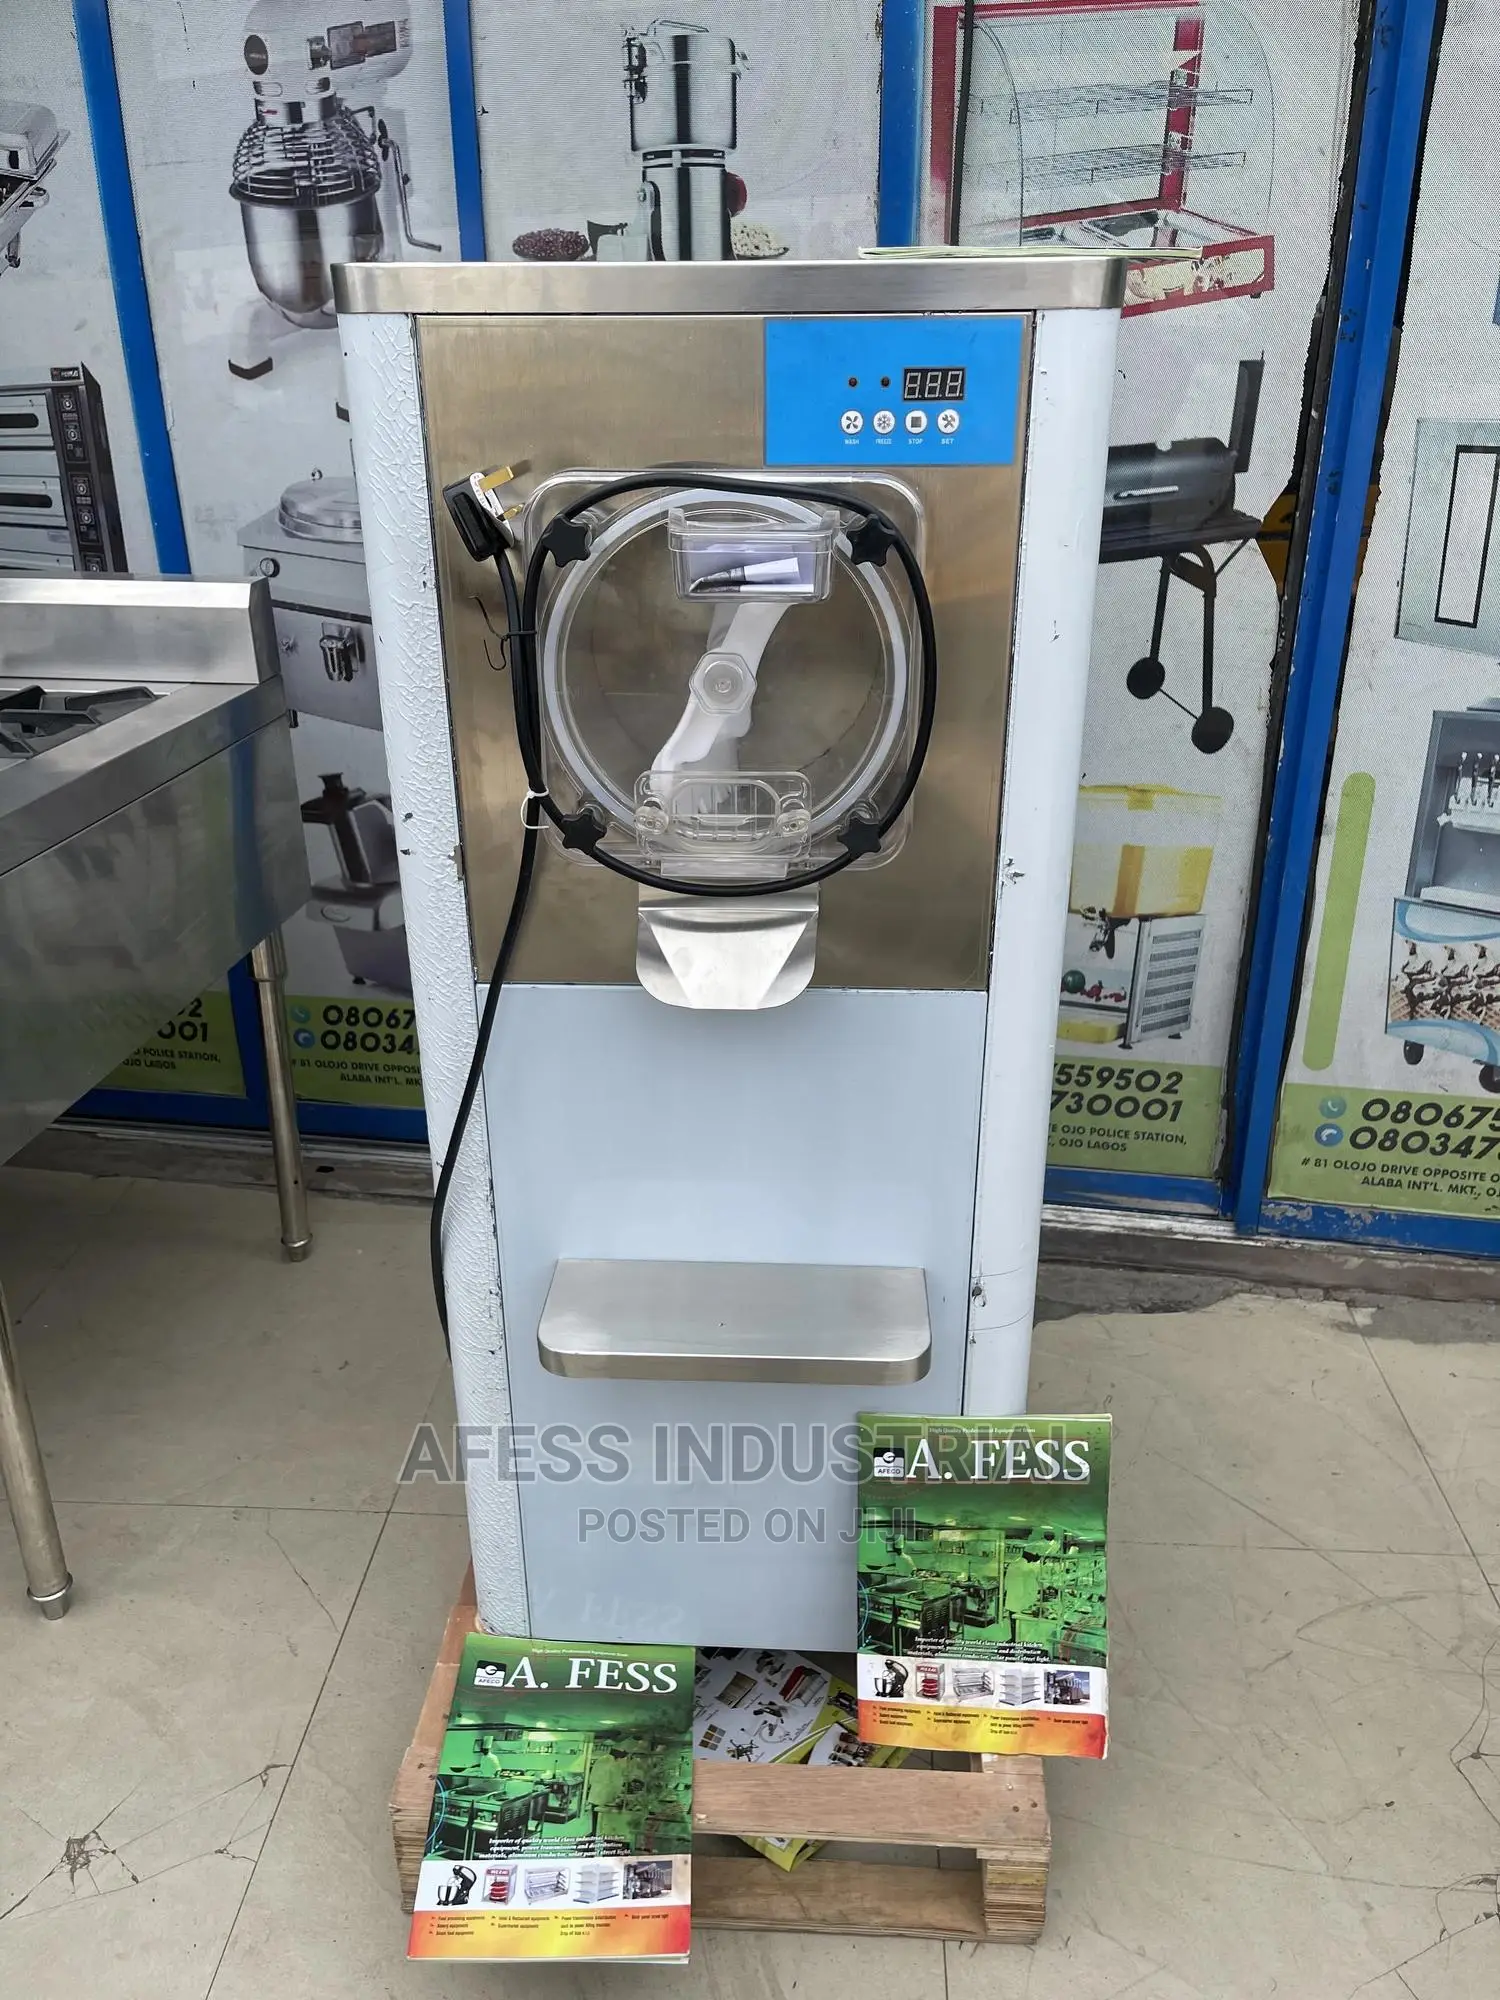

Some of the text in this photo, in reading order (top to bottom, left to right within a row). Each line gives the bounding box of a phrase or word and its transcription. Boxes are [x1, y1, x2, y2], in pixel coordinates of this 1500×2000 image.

[322, 1005, 416, 1029] 08067
[320, 1030, 420, 1055] 08034
[143, 1048, 175, 1058] POLICE
[177, 1050, 221, 1063] STATION,
[314, 1060, 348, 1070] OLOJO
[351, 1061, 379, 1071] DRIVE
[340, 1073, 371, 1083] ALABA
[1054, 1062, 1183, 1094] 559502
[1059, 1137, 1083, 1148] OJO
[1087, 1140, 1127, 1151] LAGOS
[1061, 1125, 1085, 1135] OJO
[1089, 1127, 1130, 1140] POLICE
[1133, 1130, 1187, 1145] STATION,
[1349, 1126, 1500, 1160] 080347
[1314, 1158, 1328, 1168] 81
[1333, 1160, 1376, 1172] OLOJO
[1381, 1163, 1419, 1176] DRIVE
[1423, 1167, 1486, 1182] OPPOSITE
[1361, 1176, 1402, 1189] ALABA
[905, 1438, 1090, 1481] A. FESS
[504, 1656, 678, 1693] A. FESS
